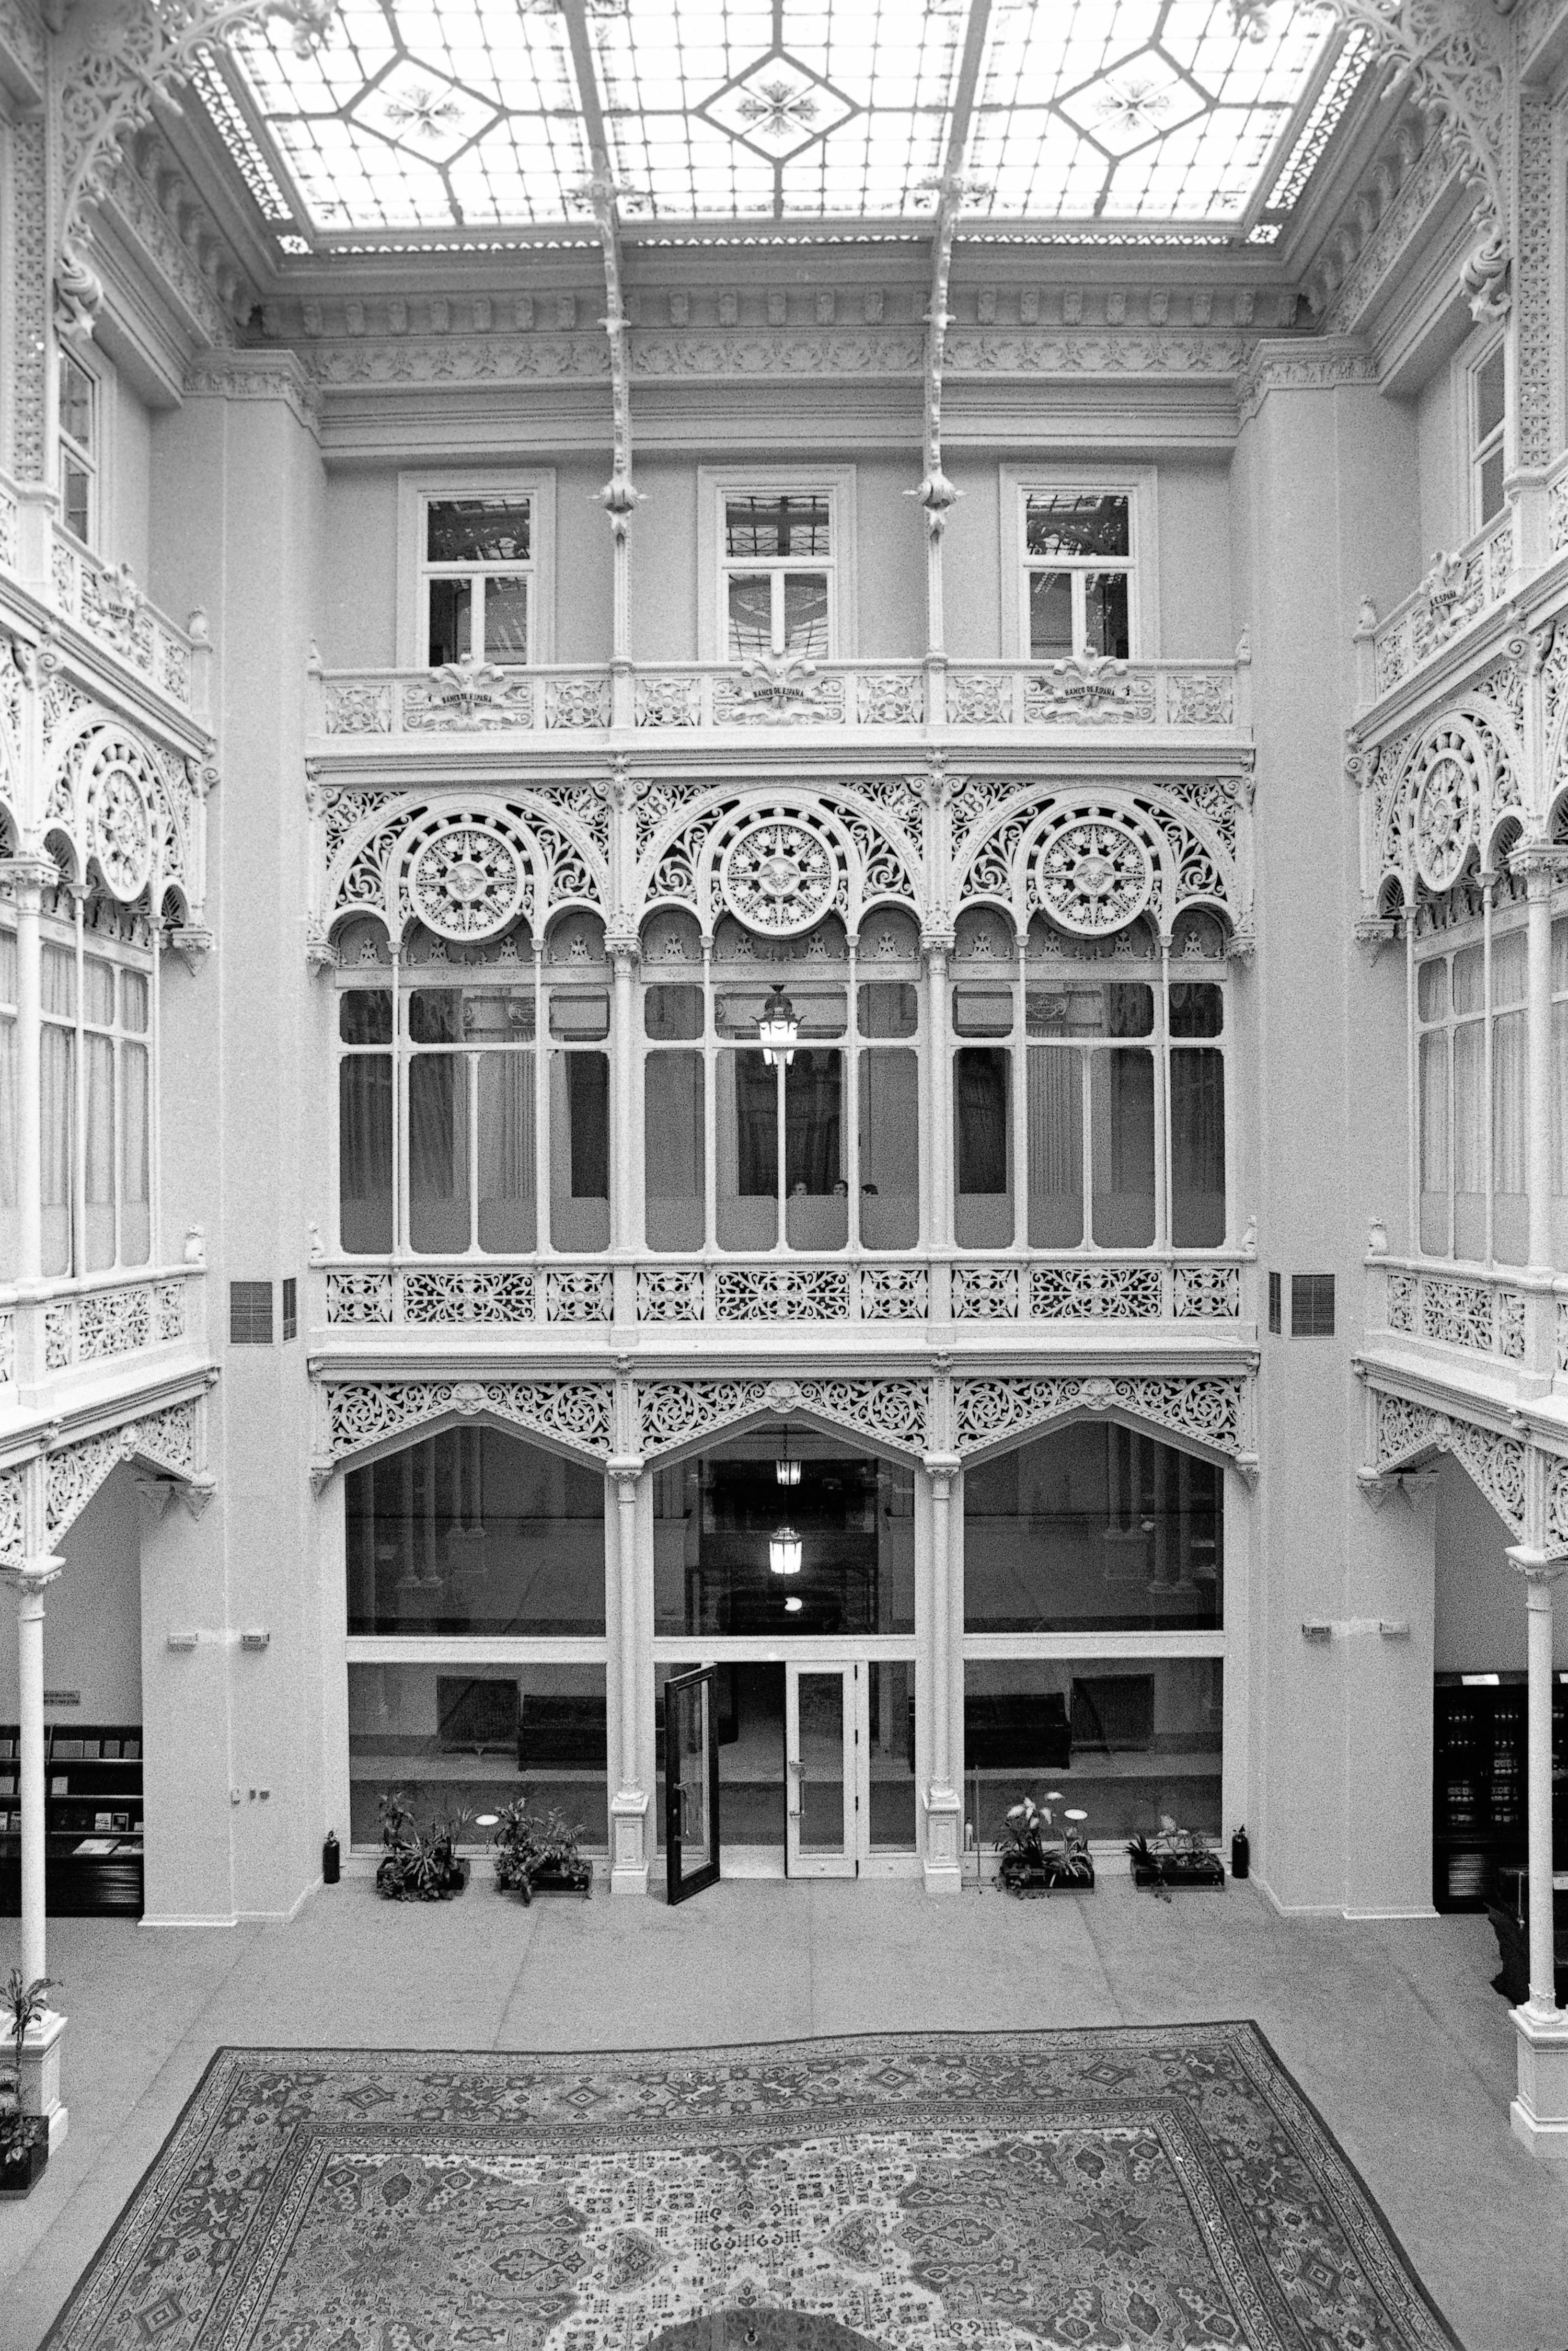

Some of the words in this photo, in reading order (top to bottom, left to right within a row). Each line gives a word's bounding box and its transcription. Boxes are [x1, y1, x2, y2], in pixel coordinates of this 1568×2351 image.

[753, 688, 773, 698] BANCO
[1064, 686, 1086, 696] BANCO
[442, 694, 460, 704] BANCO
